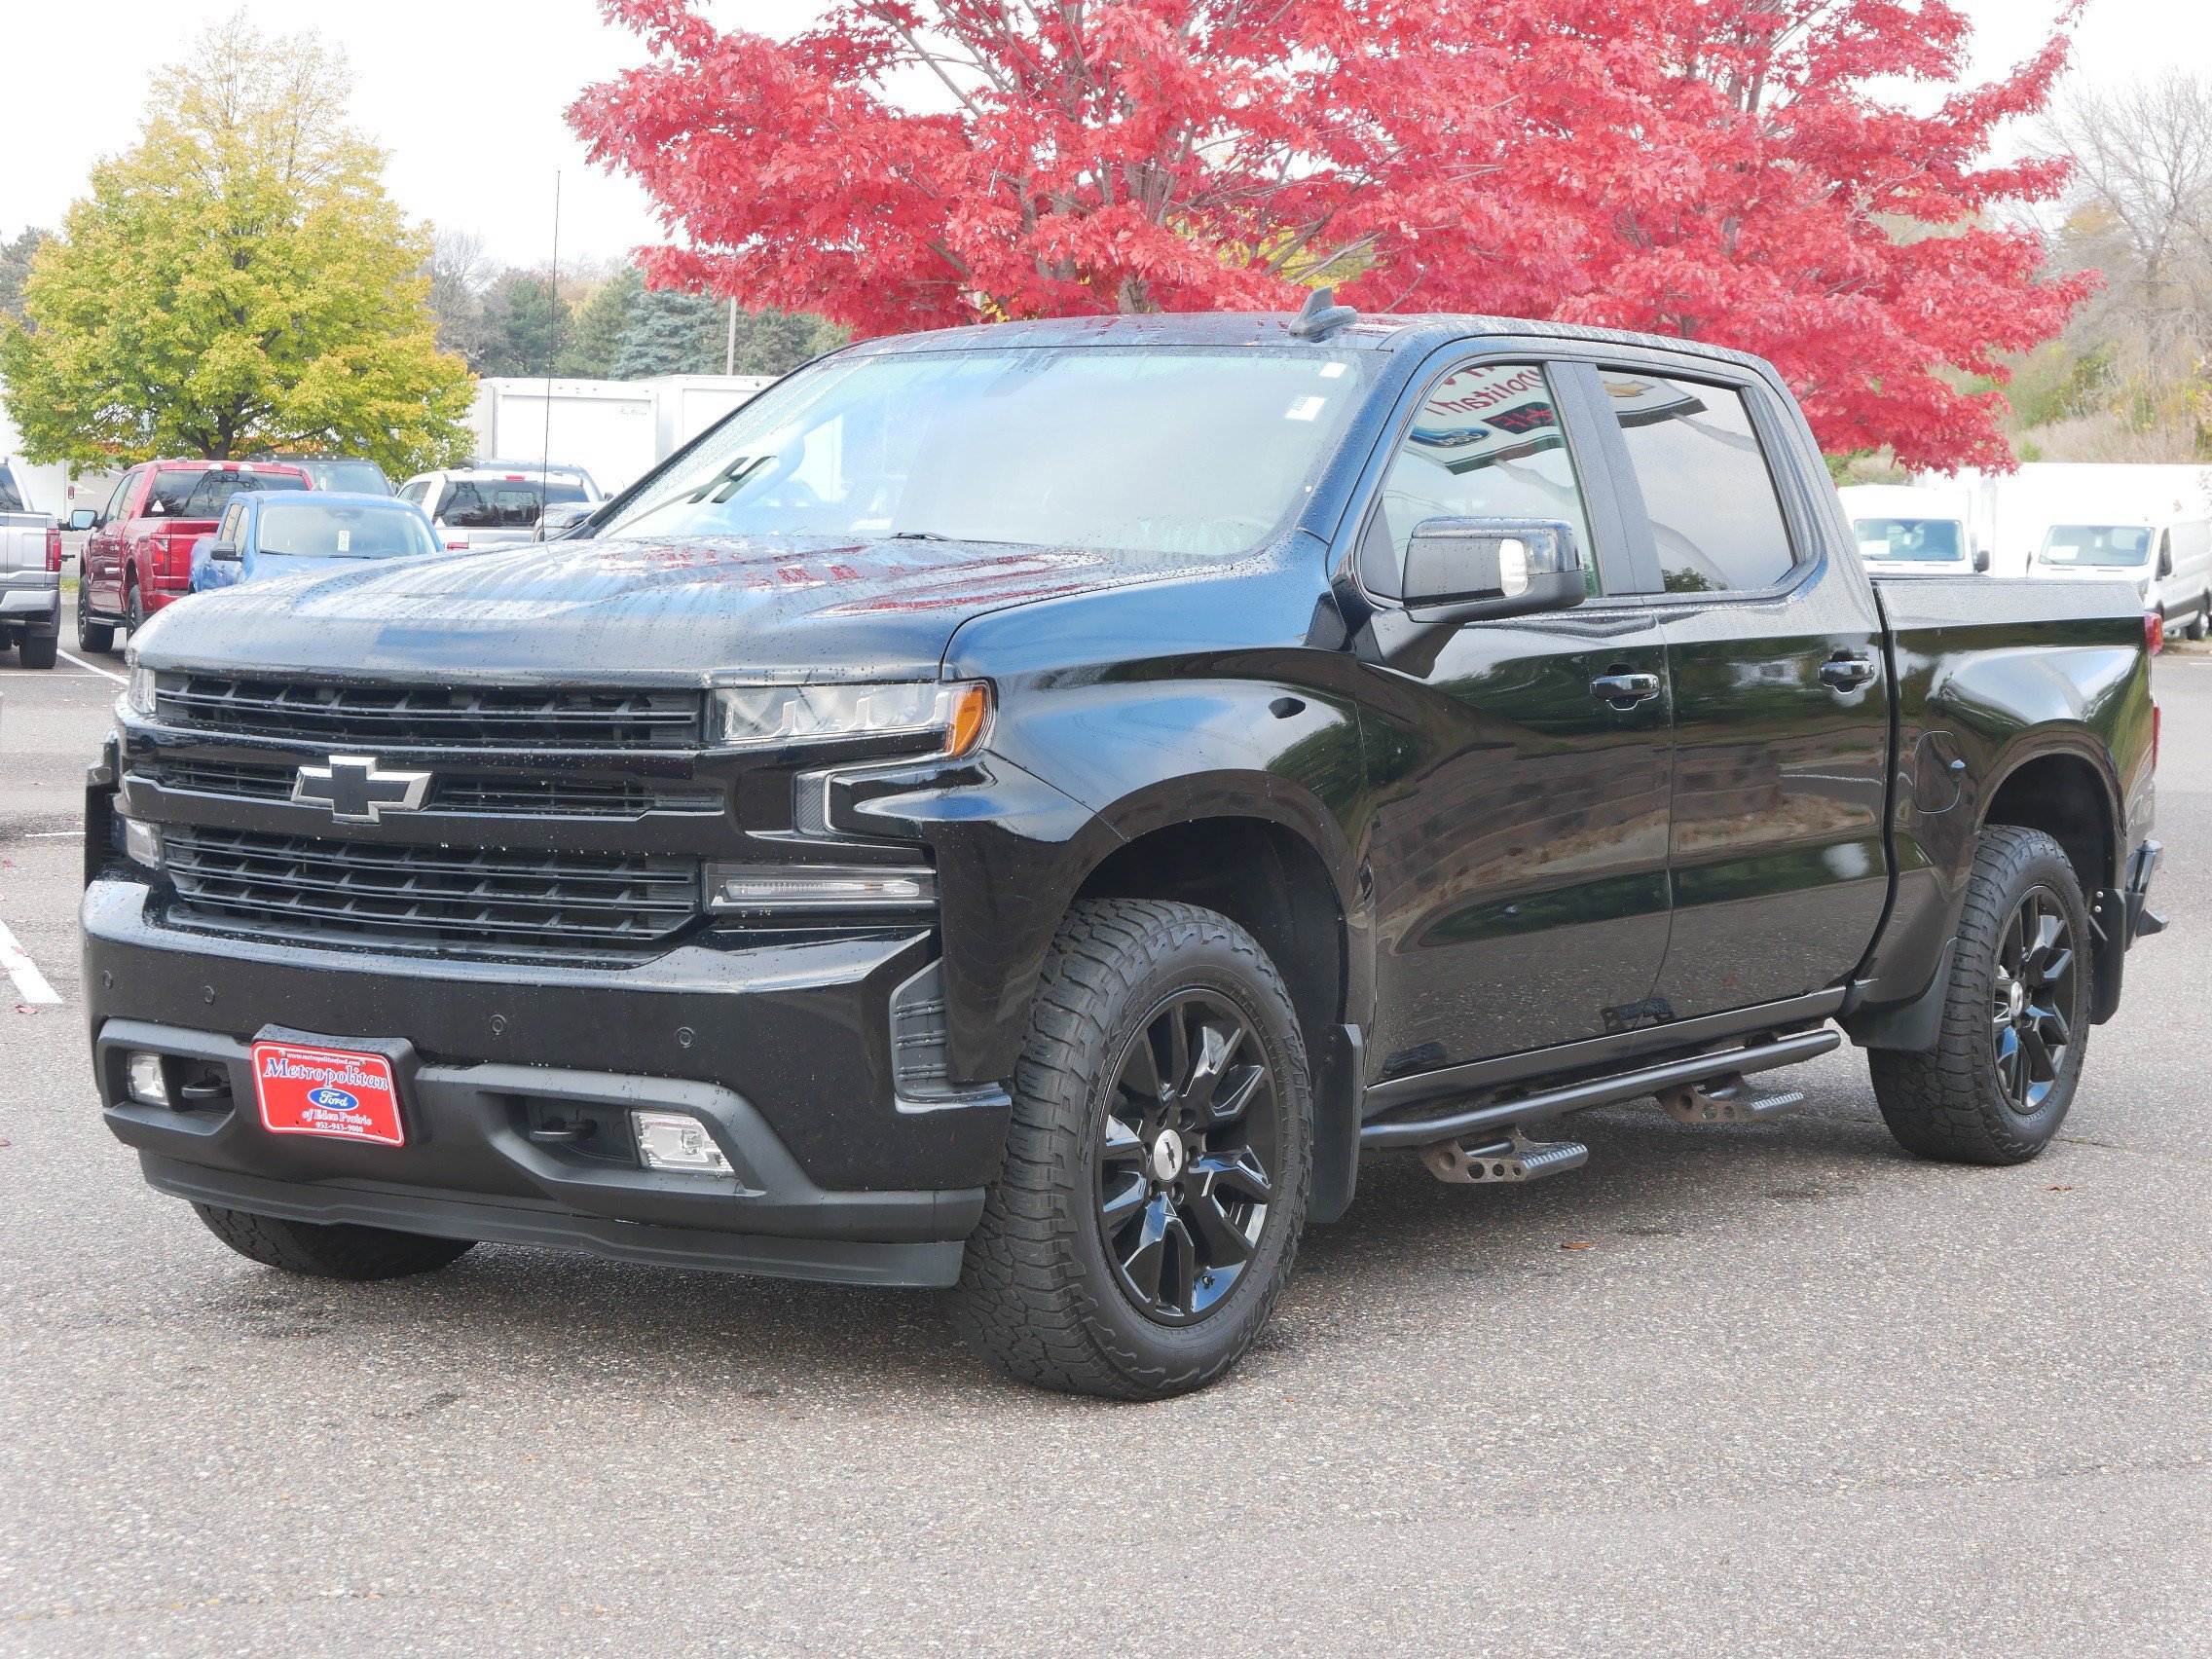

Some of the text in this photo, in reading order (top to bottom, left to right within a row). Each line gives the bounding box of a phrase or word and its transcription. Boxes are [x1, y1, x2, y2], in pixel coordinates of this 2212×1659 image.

[264, 1057, 388, 1090] Metropolitan
[319, 1090, 349, 1107] Ford
[302, 1108, 372, 1125] of Eden Prairie
